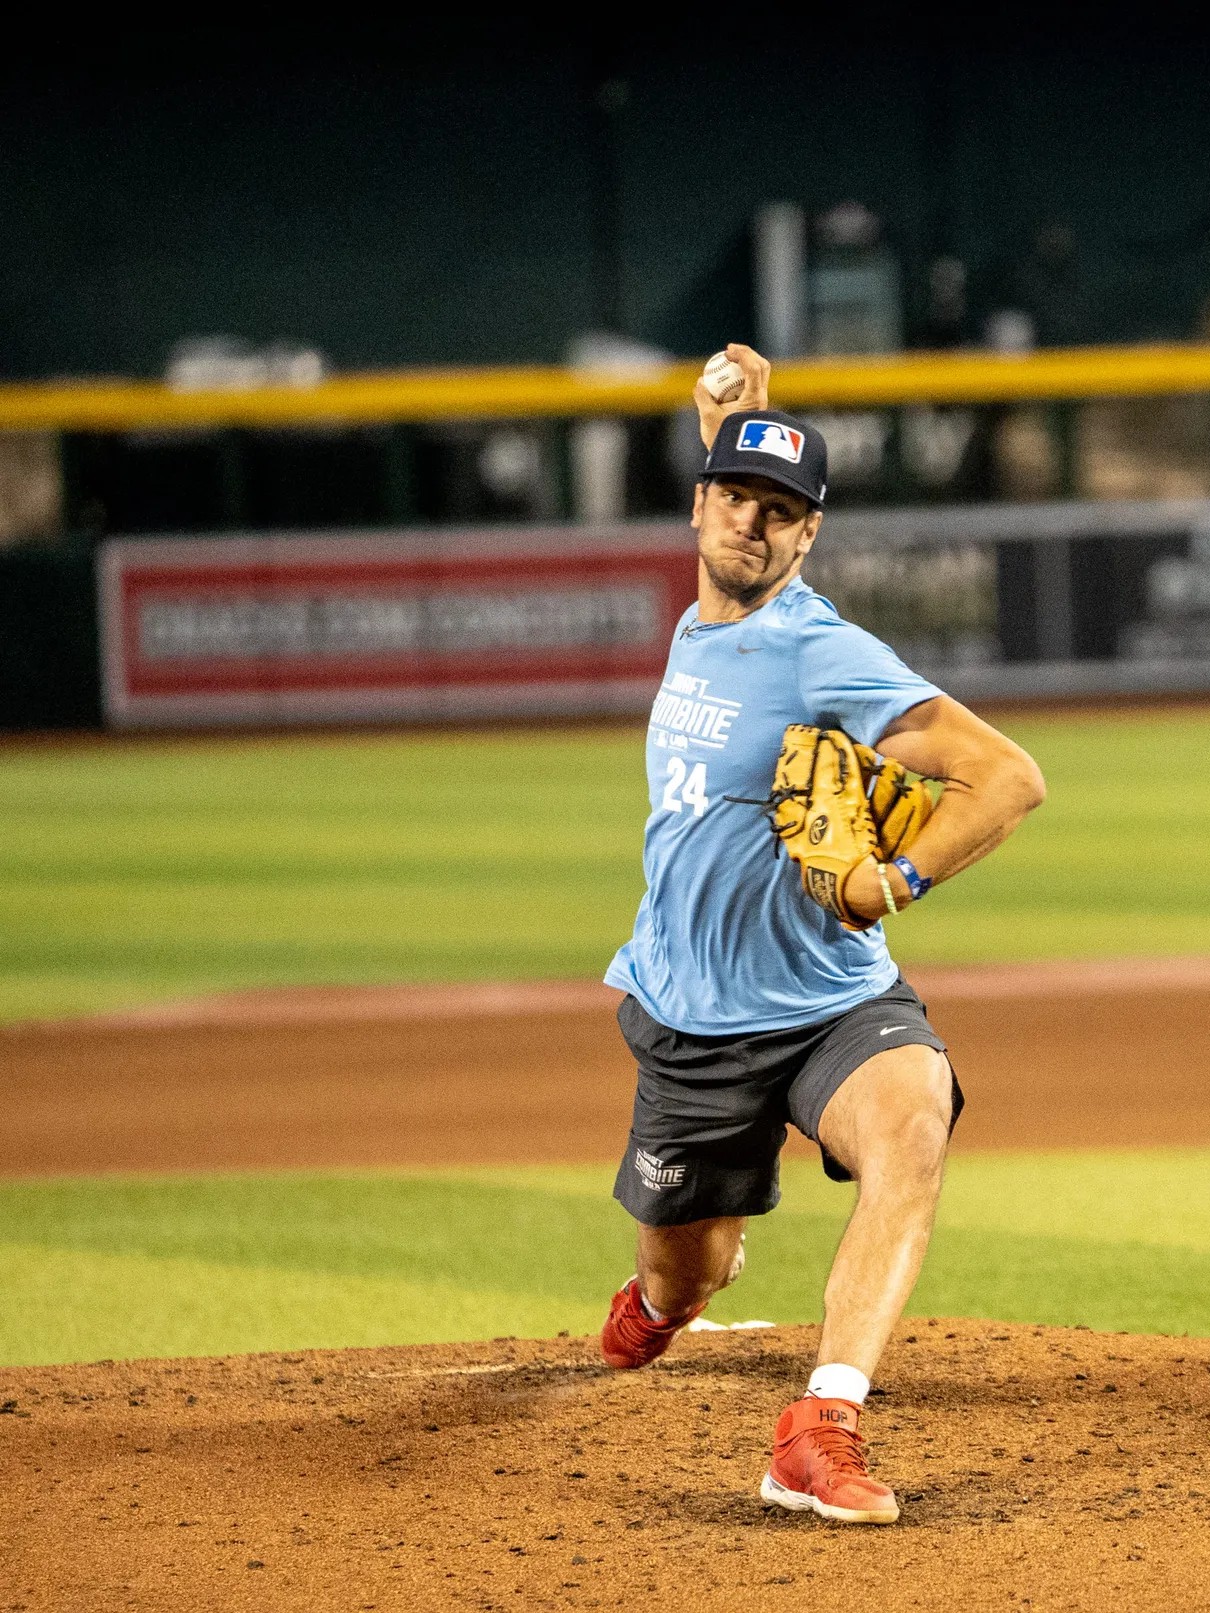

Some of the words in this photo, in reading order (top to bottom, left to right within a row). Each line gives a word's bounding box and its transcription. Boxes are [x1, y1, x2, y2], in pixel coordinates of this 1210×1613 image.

[651, 690, 739, 740] OMBINE
[662, 756, 708, 817] 24
[635, 1151, 686, 1182] COMBINE
